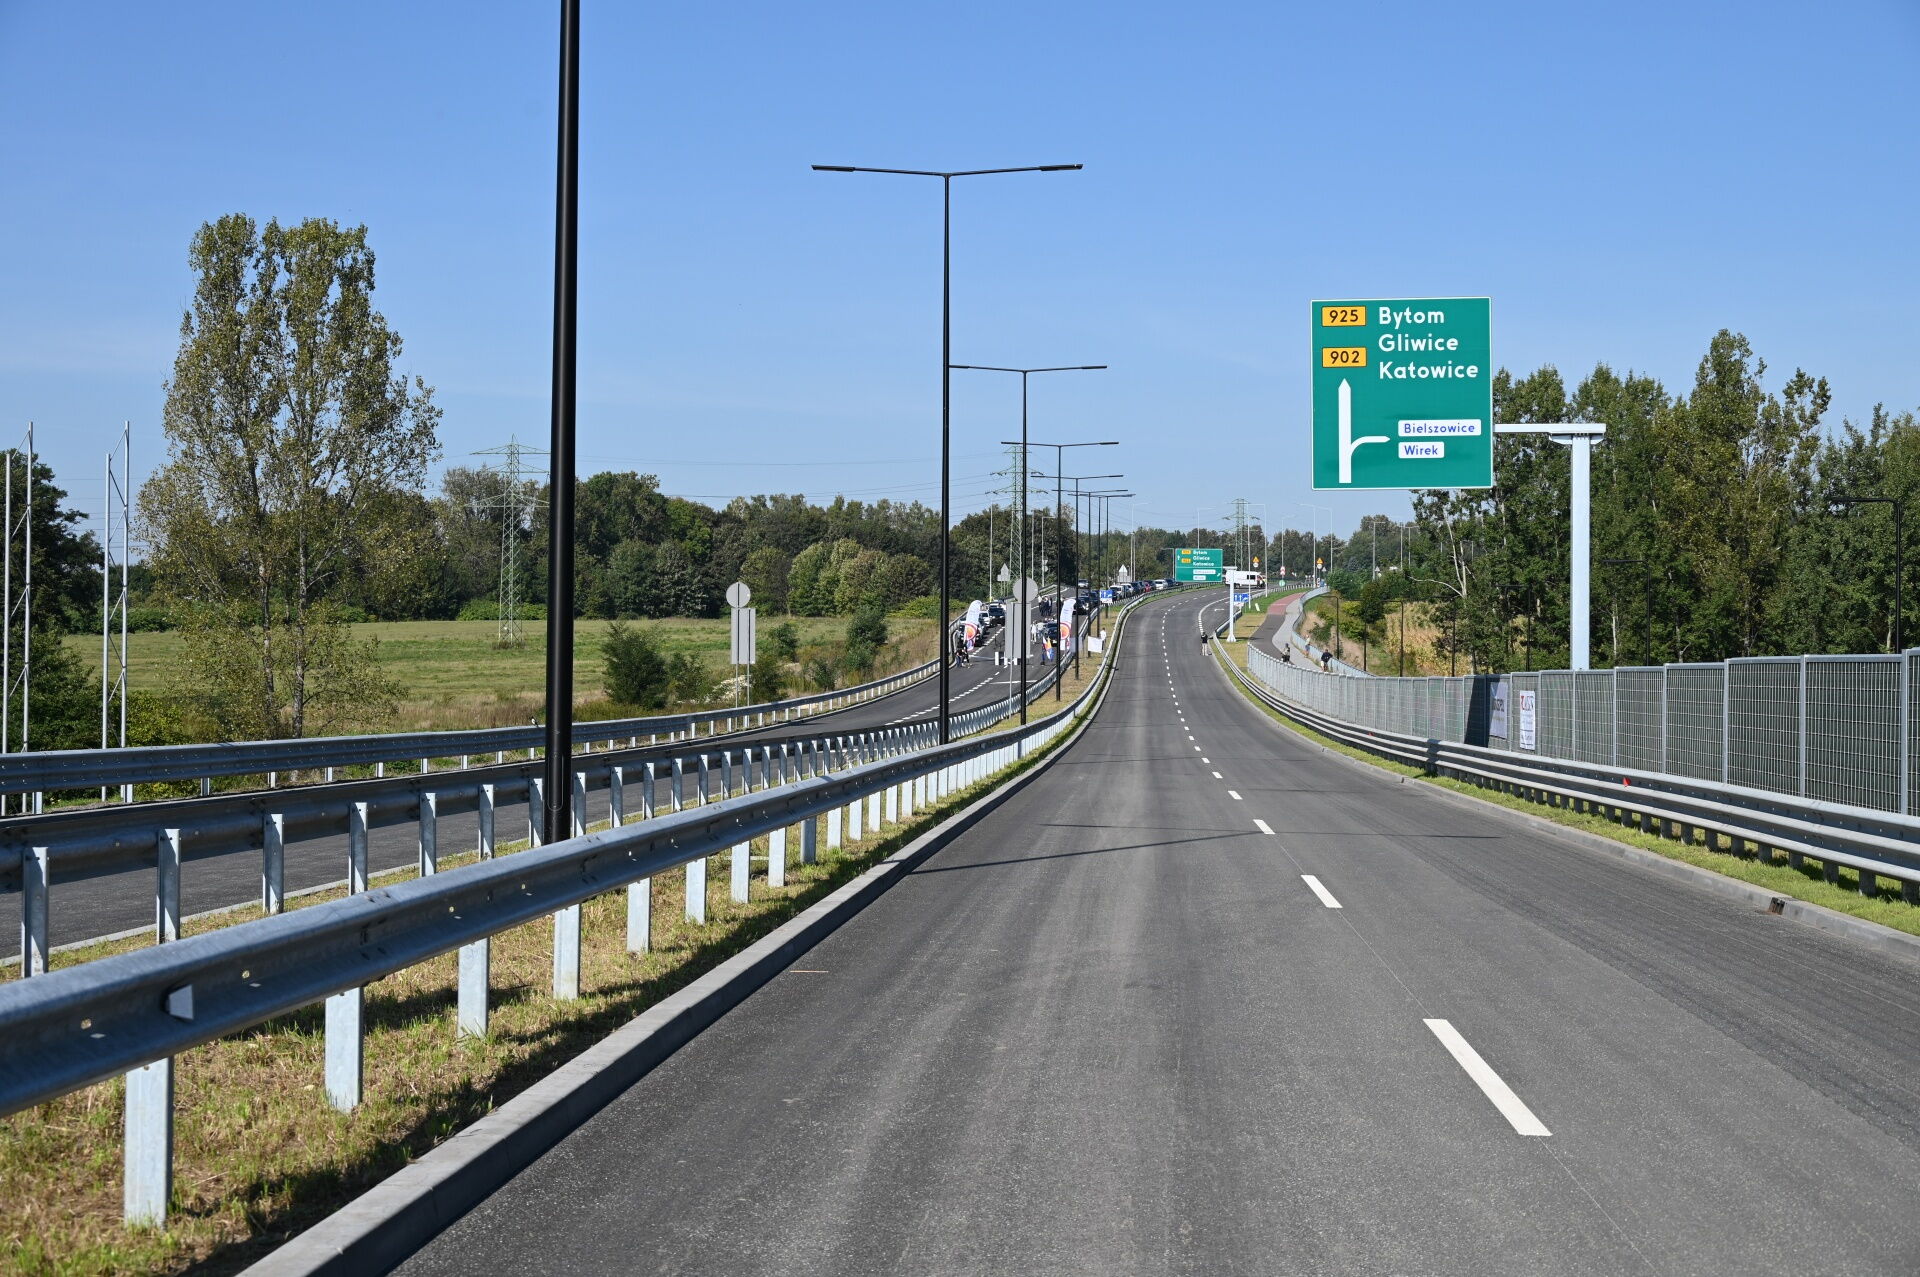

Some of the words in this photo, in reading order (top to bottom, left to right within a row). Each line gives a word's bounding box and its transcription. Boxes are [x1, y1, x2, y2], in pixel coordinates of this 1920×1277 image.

[1329, 309, 1359, 323] 925
[1378, 306, 1445, 330] Bytom
[1378, 333, 1459, 352] Gliwice
[1330, 350, 1360, 364] 902
[1379, 360, 1479, 380] Katowice
[1404, 422, 1475, 434] Bielszowice
[1404, 444, 1438, 456] Wirek
